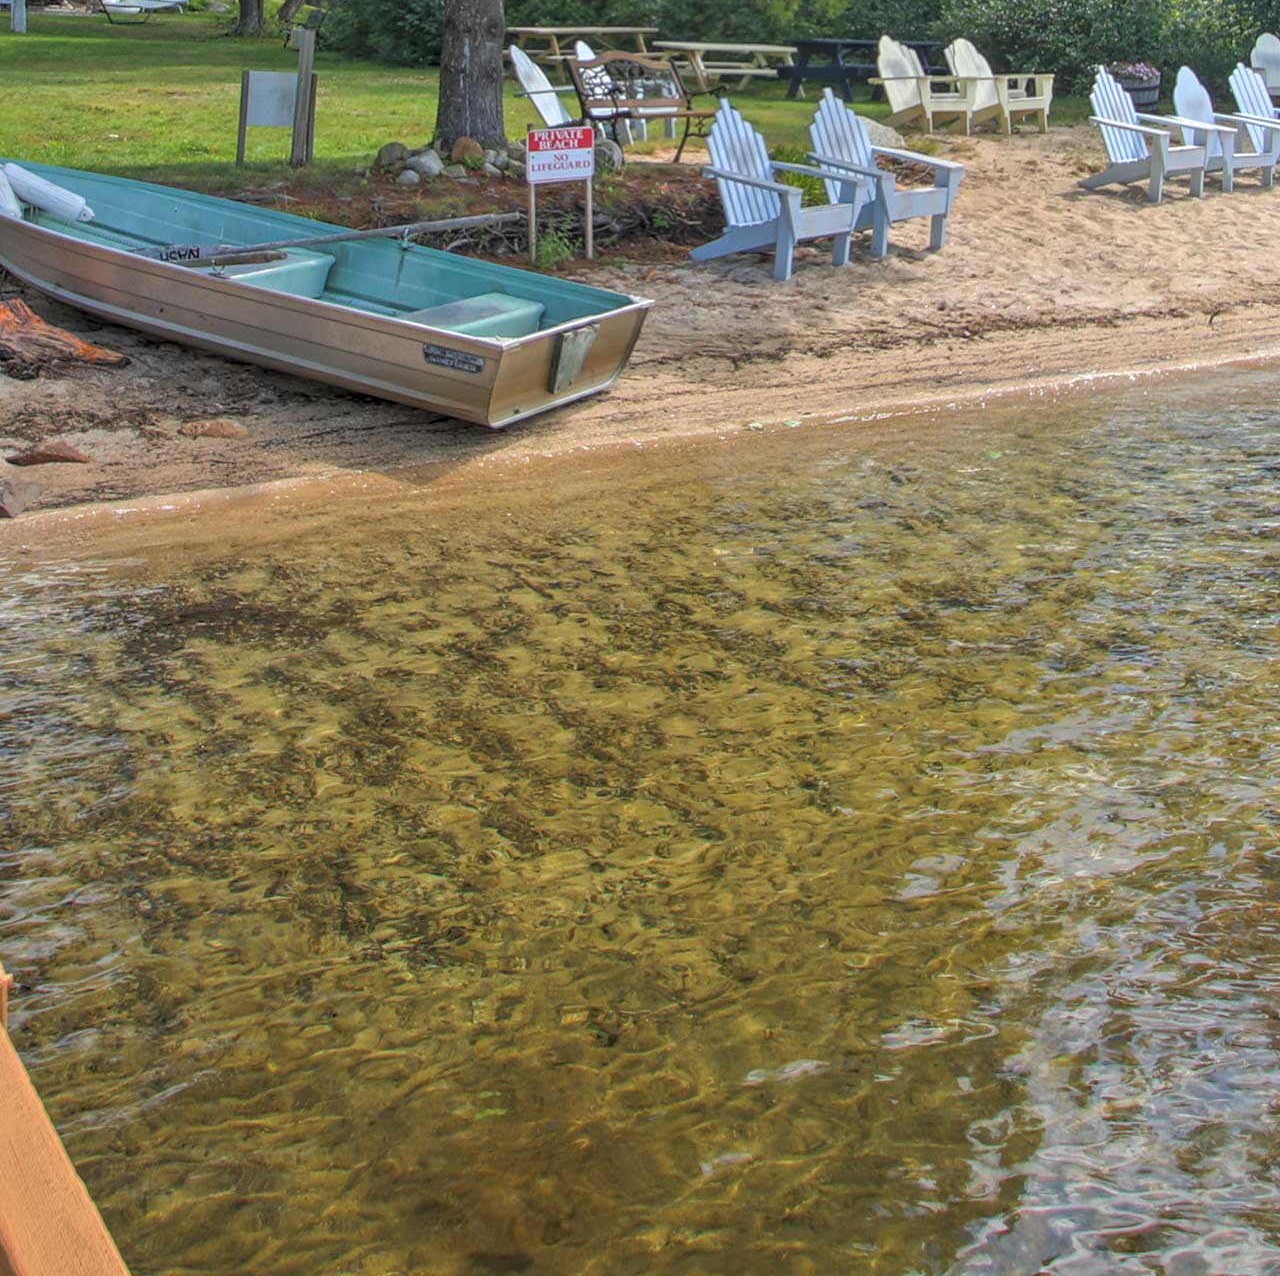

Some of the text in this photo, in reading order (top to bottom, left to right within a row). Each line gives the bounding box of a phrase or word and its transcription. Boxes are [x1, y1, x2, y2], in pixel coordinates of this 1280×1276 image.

[534, 129, 584, 141] PRIVATE
[539, 139, 579, 150] BEACH
[553, 153, 569, 162] NO
[531, 160, 591, 172] LIFEGUARD
